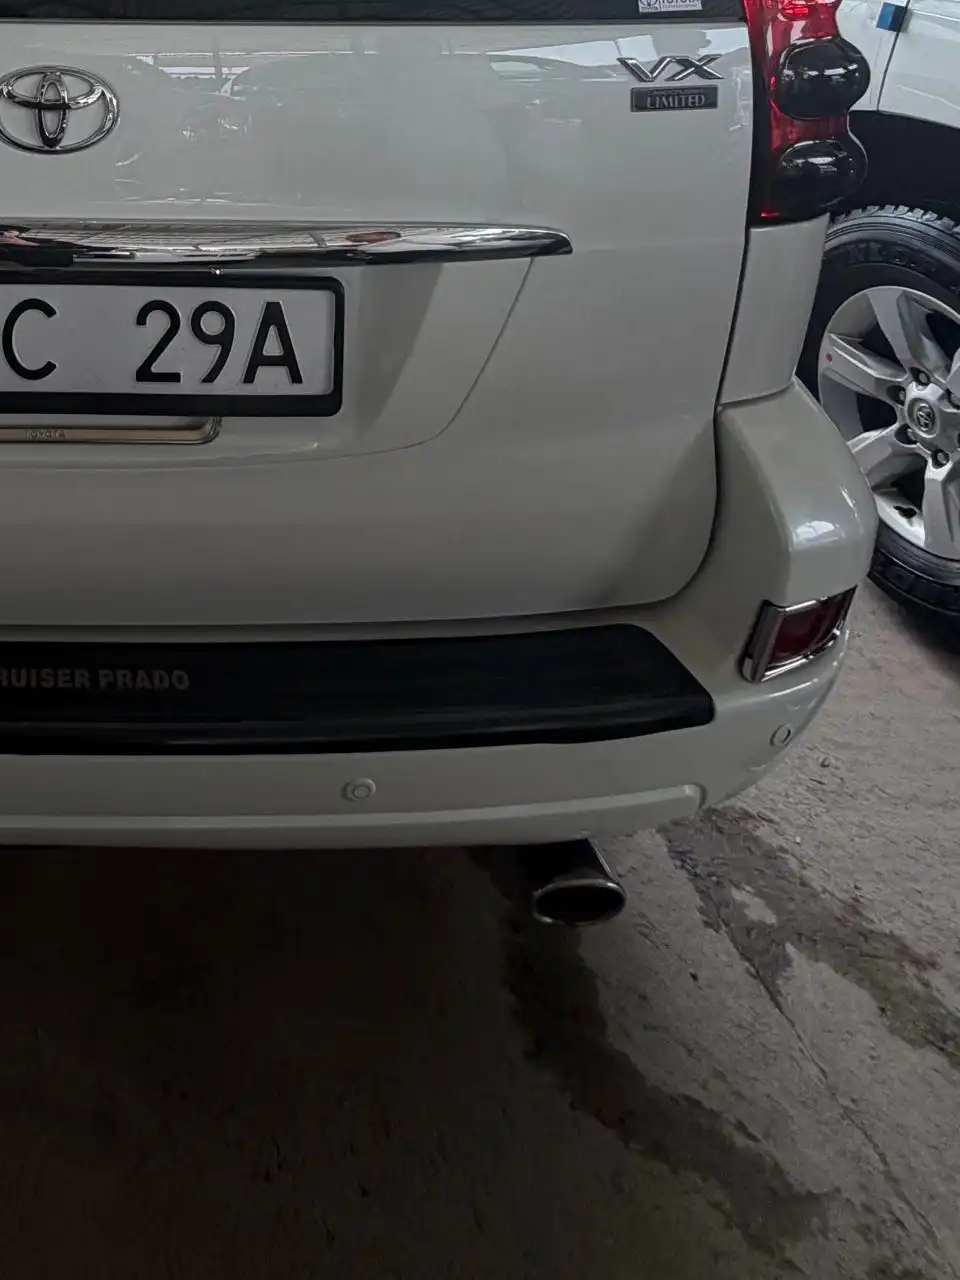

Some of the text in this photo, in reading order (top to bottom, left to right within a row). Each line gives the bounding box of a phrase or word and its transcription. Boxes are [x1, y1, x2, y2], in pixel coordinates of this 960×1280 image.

[616, 53, 726, 82] VX
[646, 94, 706, 109] LIMITED
[134, 298, 304, 386] 29A
[97, 668, 190, 691] PRADO
